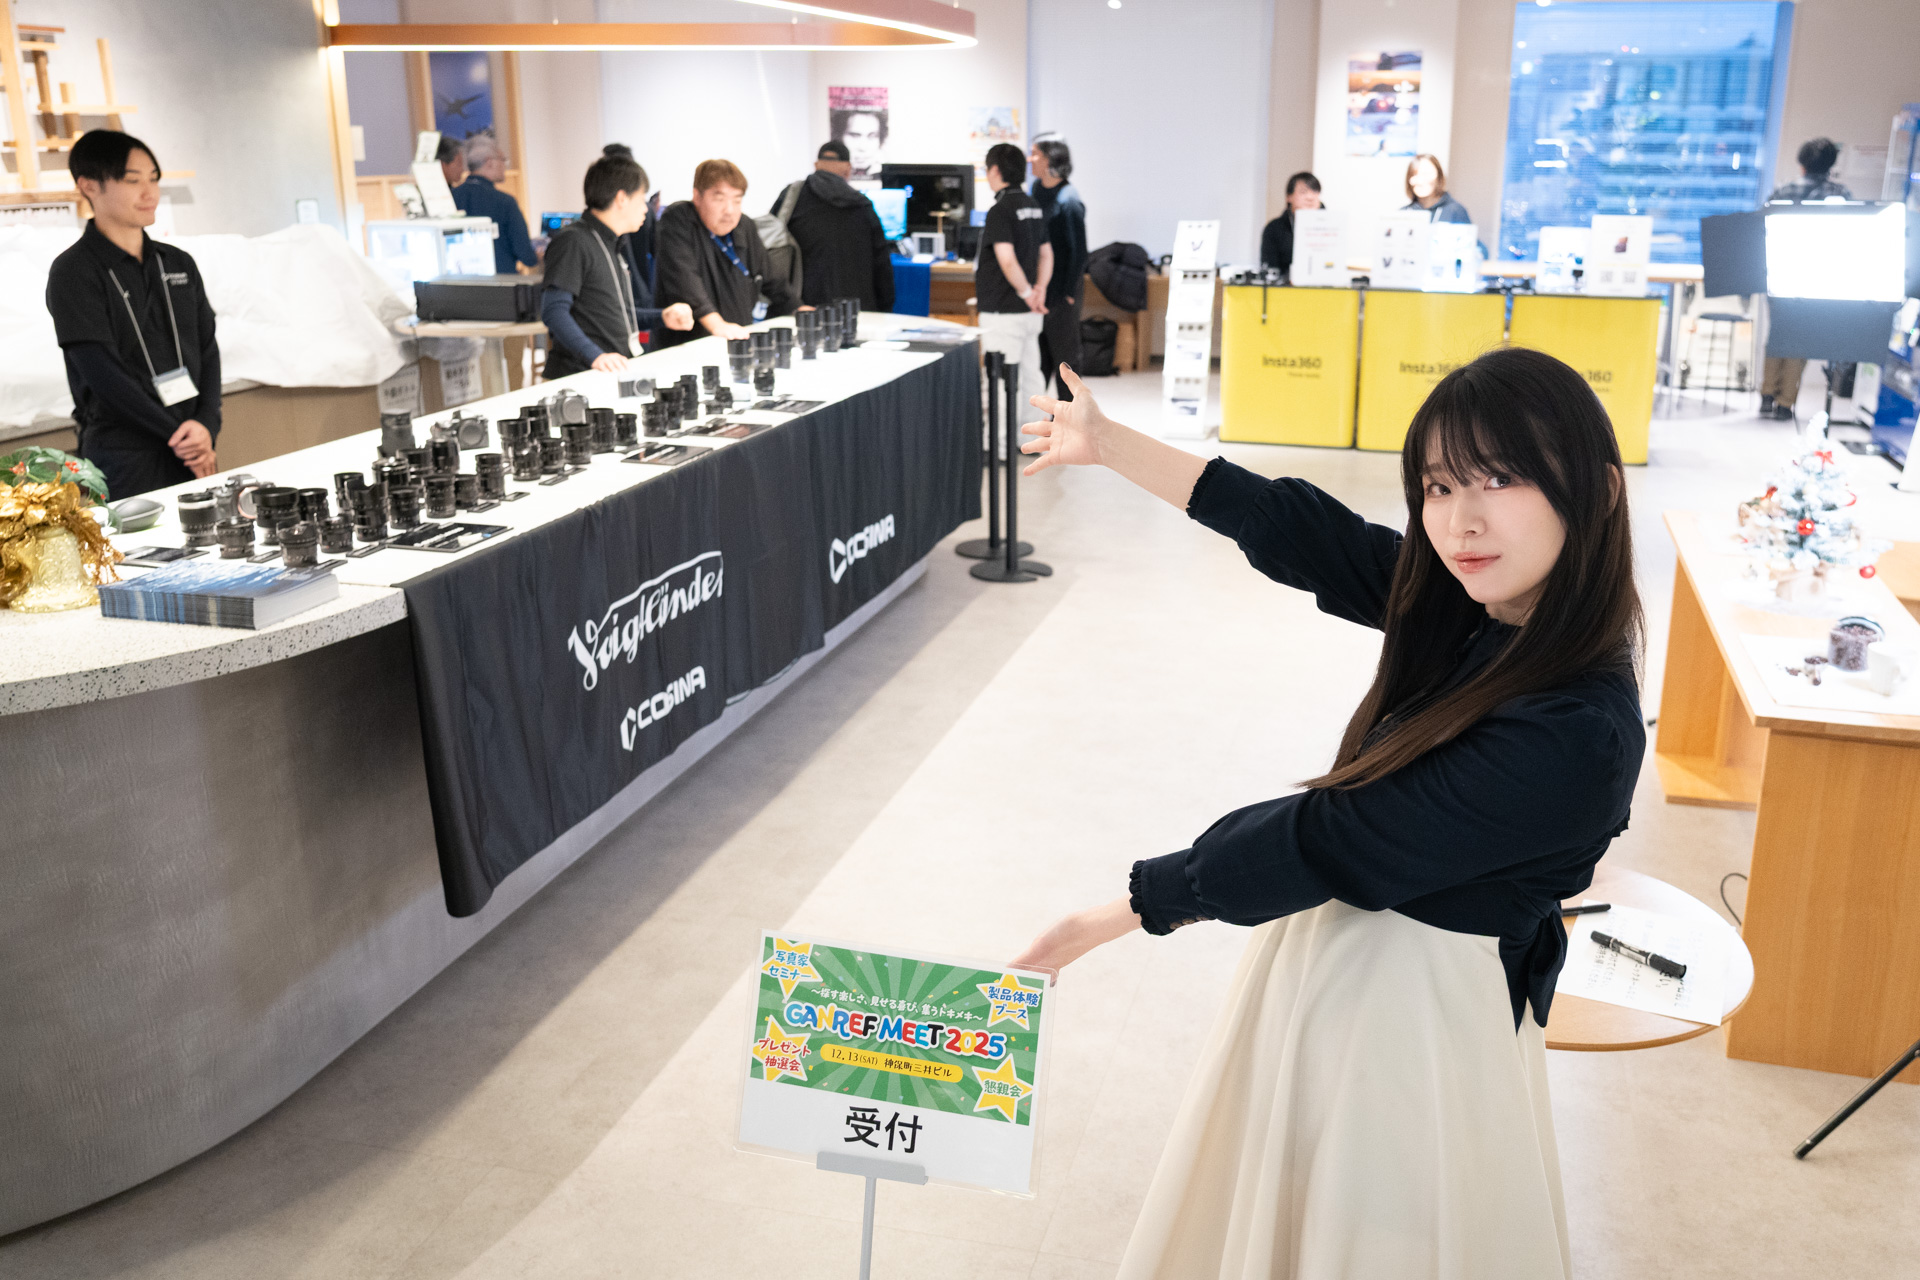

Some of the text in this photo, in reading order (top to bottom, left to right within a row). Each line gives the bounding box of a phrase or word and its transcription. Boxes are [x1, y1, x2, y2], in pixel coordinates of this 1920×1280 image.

[775, 950, 809, 967] 写真家
[769, 965, 812, 980] セミナー
[988, 986, 1039, 1006] 製品体験
[995, 1003, 1027, 1019] ブース
[785, 1003, 1005, 1057] GANREF MEET 2025
[758, 1037, 810, 1057] プレゼント
[765, 1055, 801, 1072] 抽選会
[884, 1058, 952, 1077] 神保町三井ビル
[984, 1080, 1022, 1097] 懇親会
[844, 1106, 923, 1153] 受付
